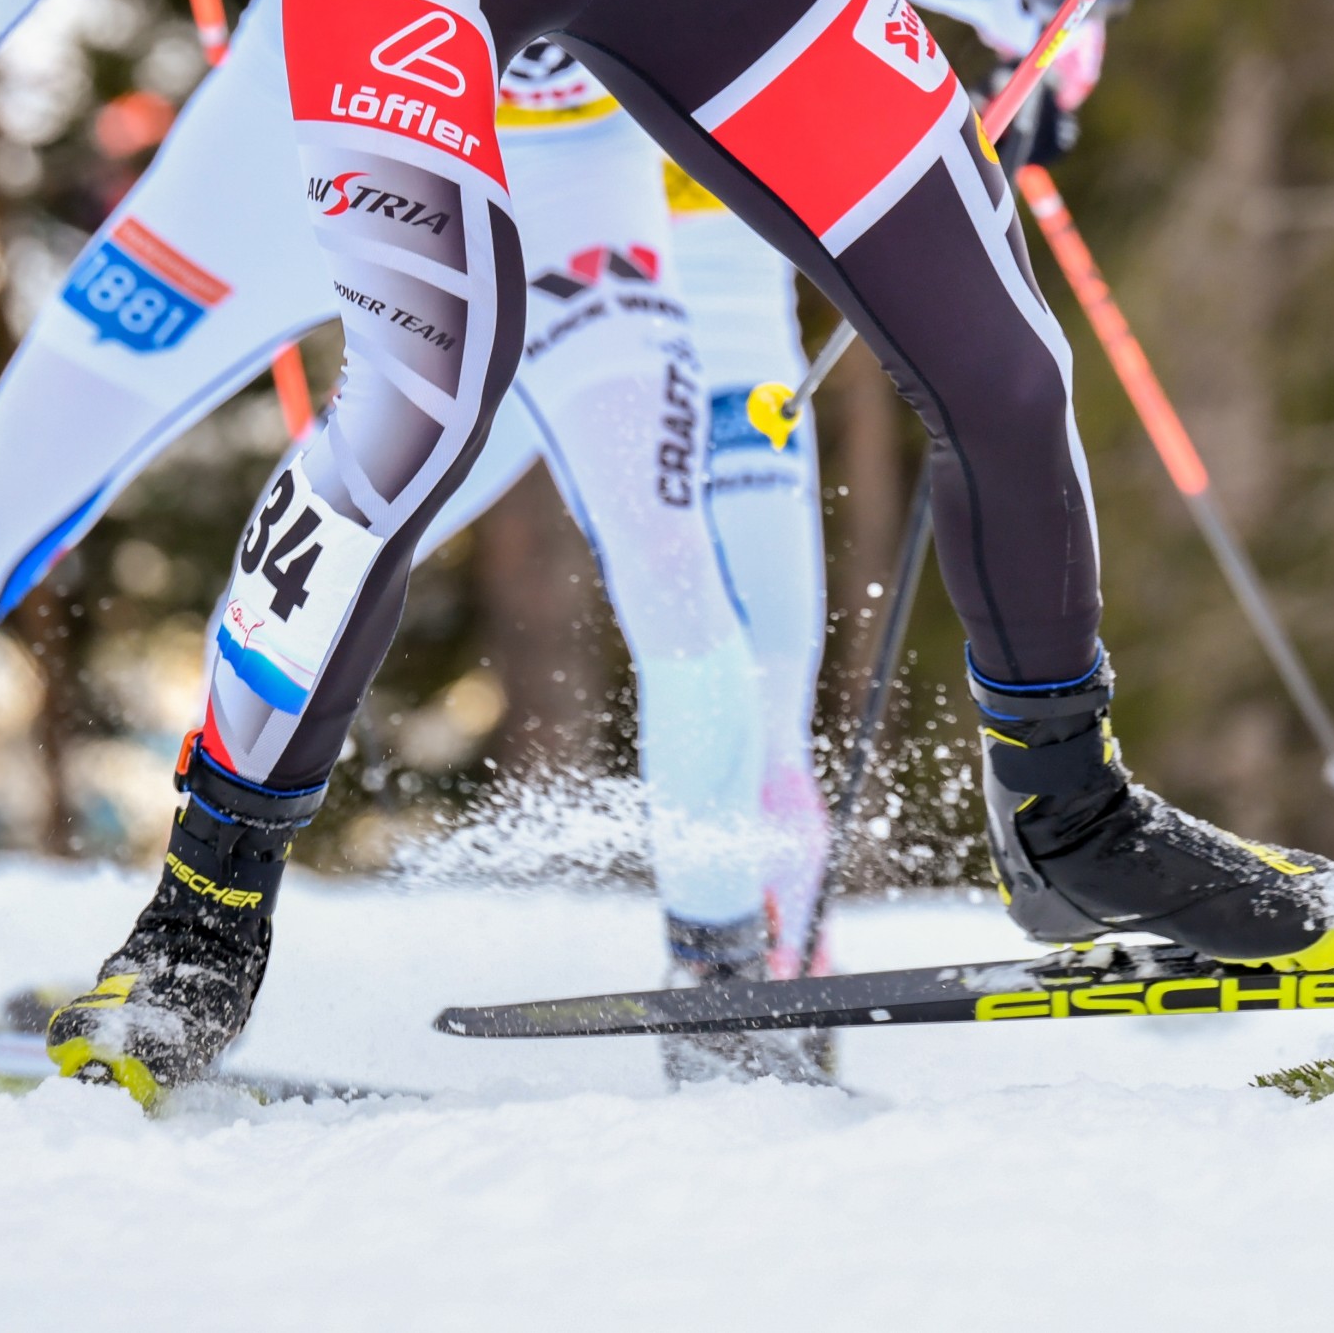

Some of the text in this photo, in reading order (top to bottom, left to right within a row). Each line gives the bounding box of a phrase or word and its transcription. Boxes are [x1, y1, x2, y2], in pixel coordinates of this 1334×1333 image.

[331, 83, 481, 158] Löffler
[307, 171, 451, 235] AUSTRIA
[74, 249, 186, 347] 1881
[333, 280, 456, 351] POWER TEAM
[657, 362, 698, 507] CRAFT
[239, 468, 324, 623] 34
[165, 851, 263, 910] FISCHER
